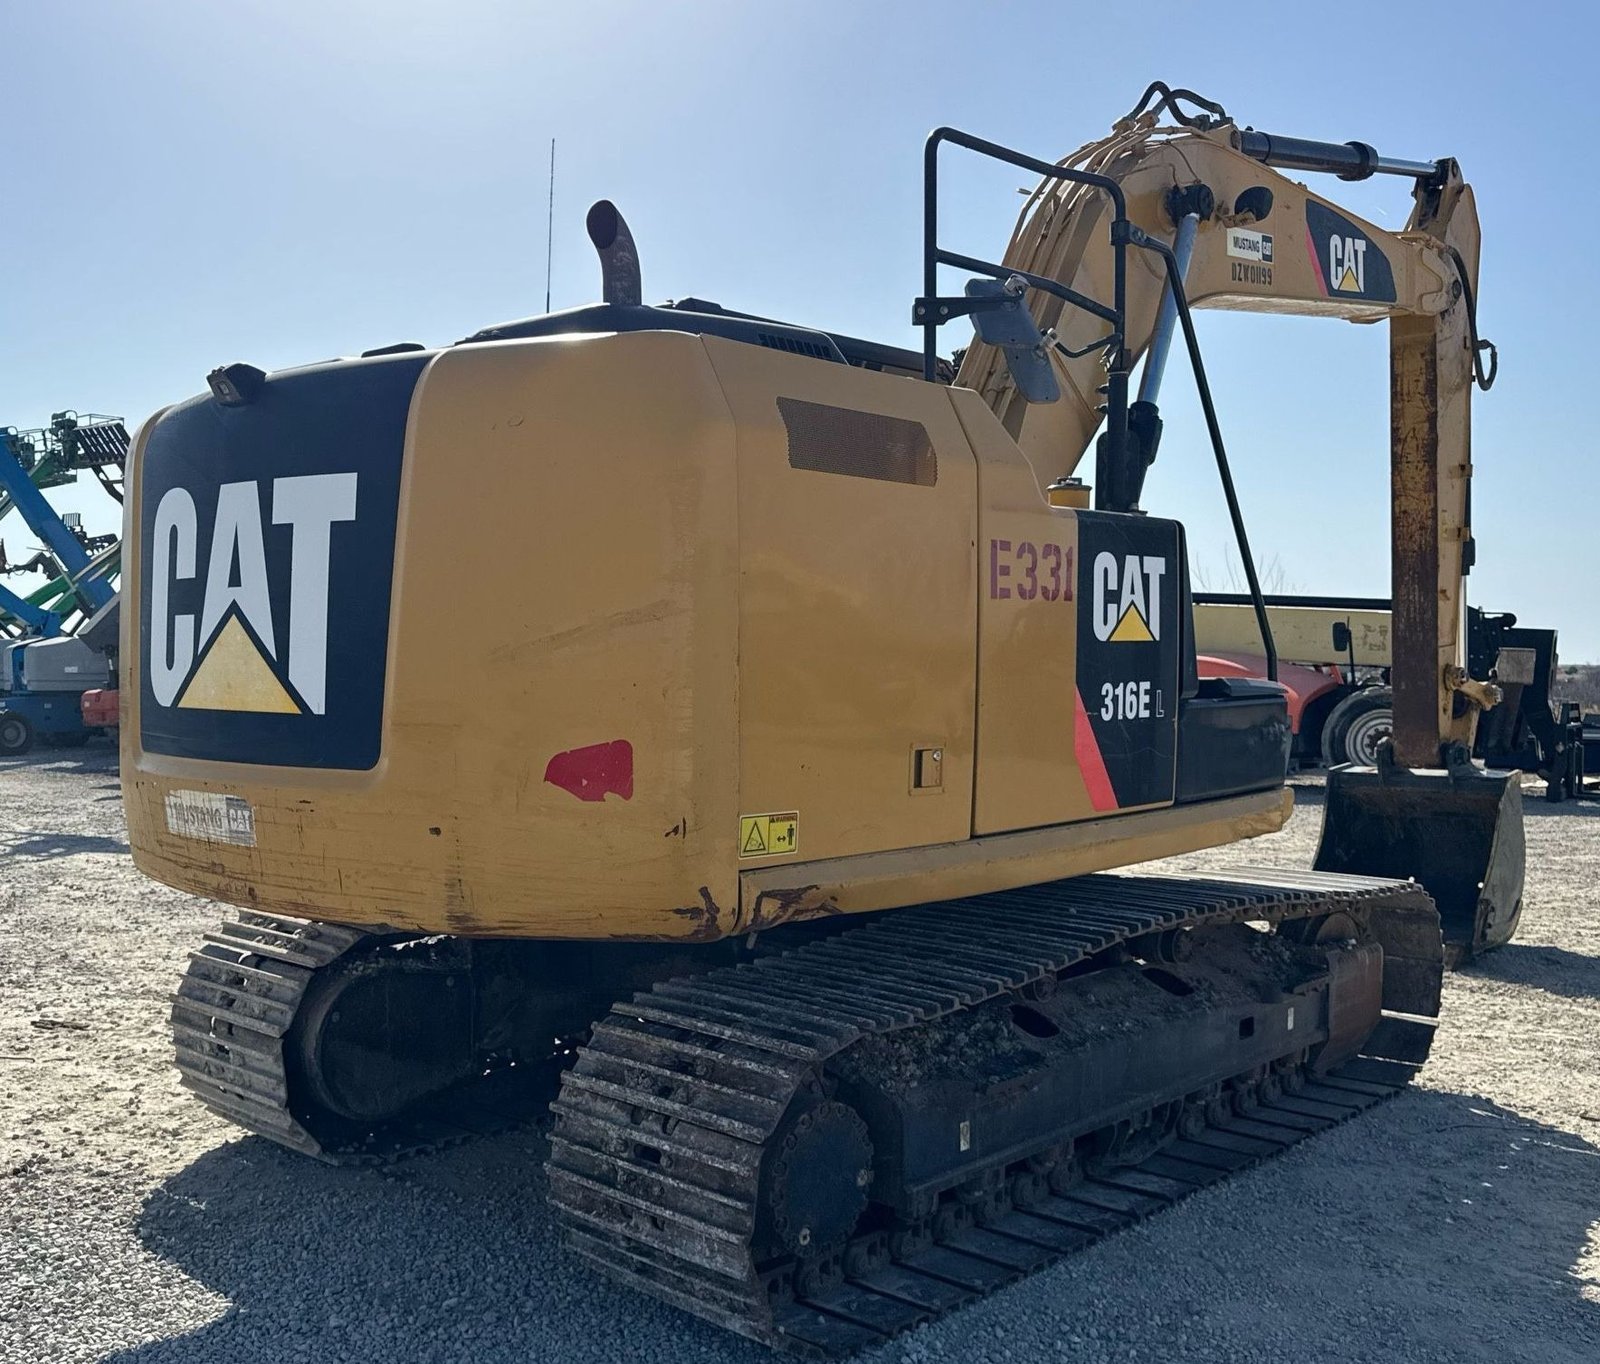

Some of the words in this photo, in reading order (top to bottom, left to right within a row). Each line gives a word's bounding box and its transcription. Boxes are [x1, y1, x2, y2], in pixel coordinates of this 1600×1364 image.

[1233, 236, 1260, 253] MUSTANG
[1330, 234, 1366, 293] CAT
[150, 472, 358, 715] CAT
[990, 539, 1073, 601] E331
[1093, 551, 1166, 642] CAT
[1100, 680, 1151, 721] 316E
[1155, 689, 1164, 717] L
[229, 809, 250, 833] CAT
